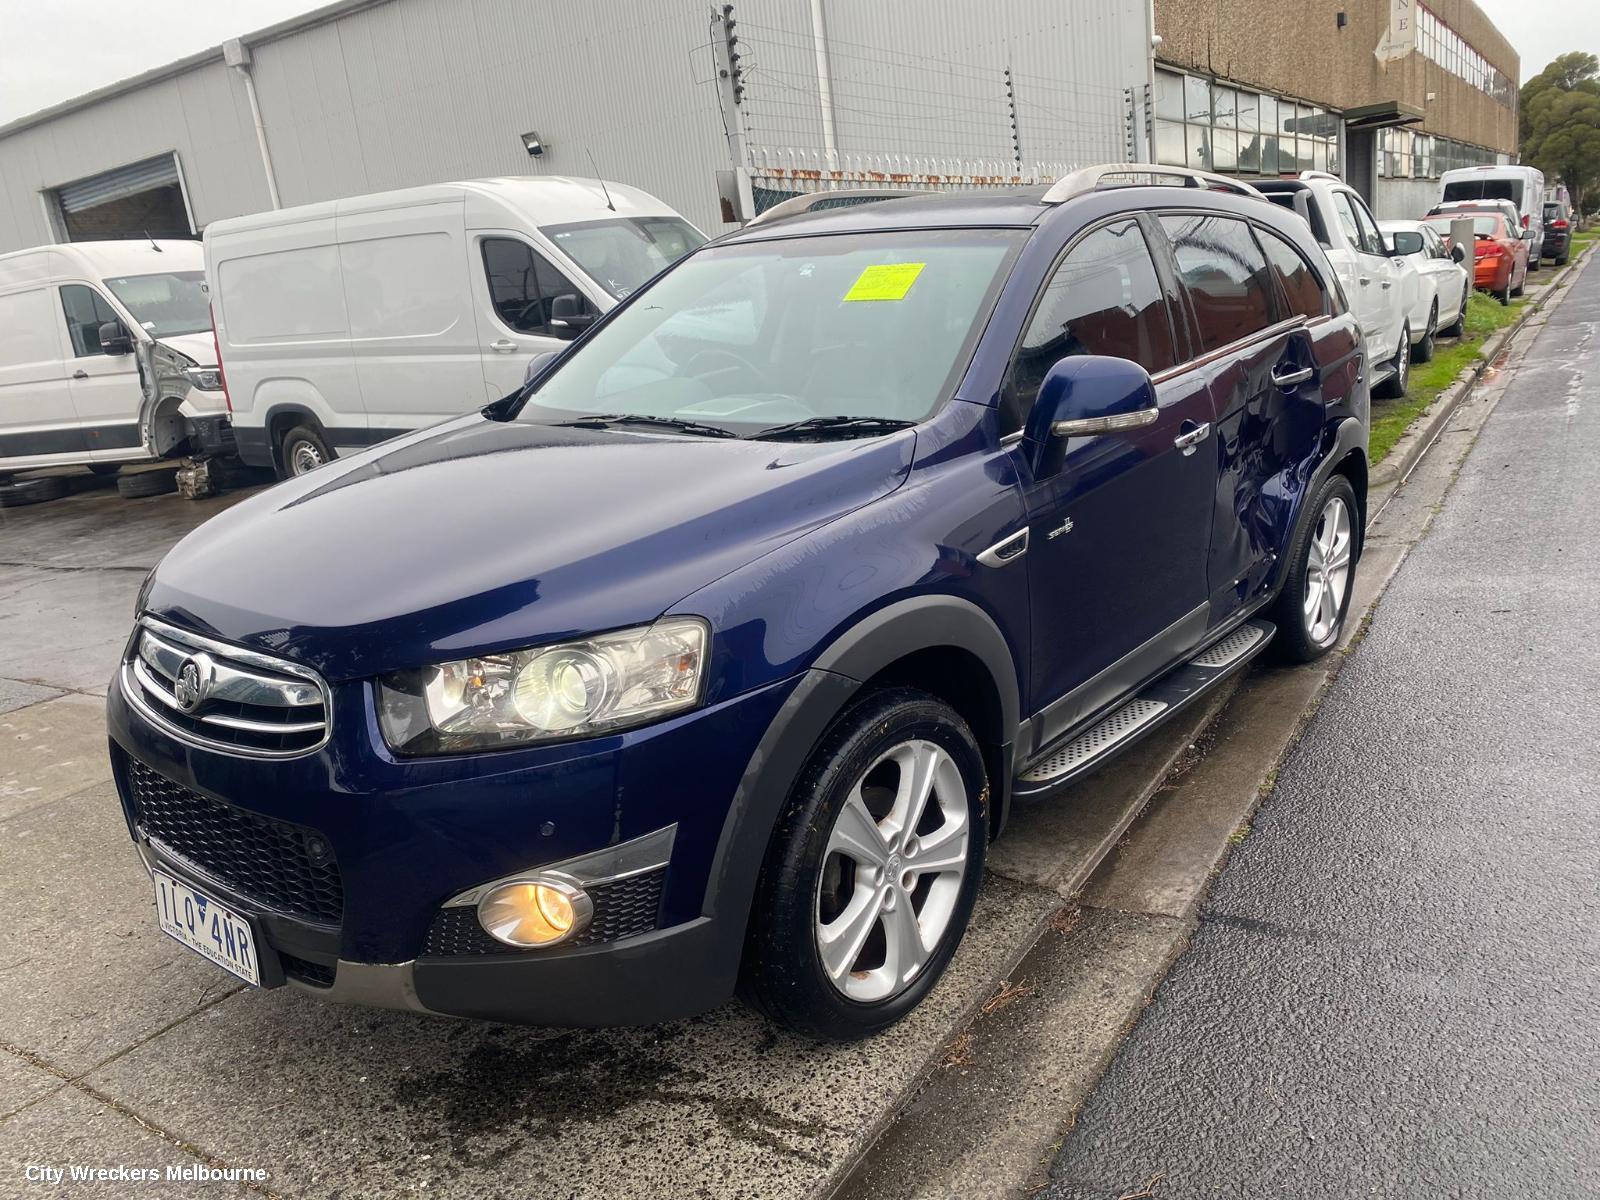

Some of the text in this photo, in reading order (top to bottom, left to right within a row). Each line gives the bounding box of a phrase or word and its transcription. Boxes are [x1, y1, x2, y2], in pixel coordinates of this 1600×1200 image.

[164, 922, 187, 941] VICTORIA
[191, 937, 202, 950] THE
[203, 944, 234, 968] EDUCATION
[234, 962, 252, 979] STATE
[212, 913, 252, 969] 4NR
